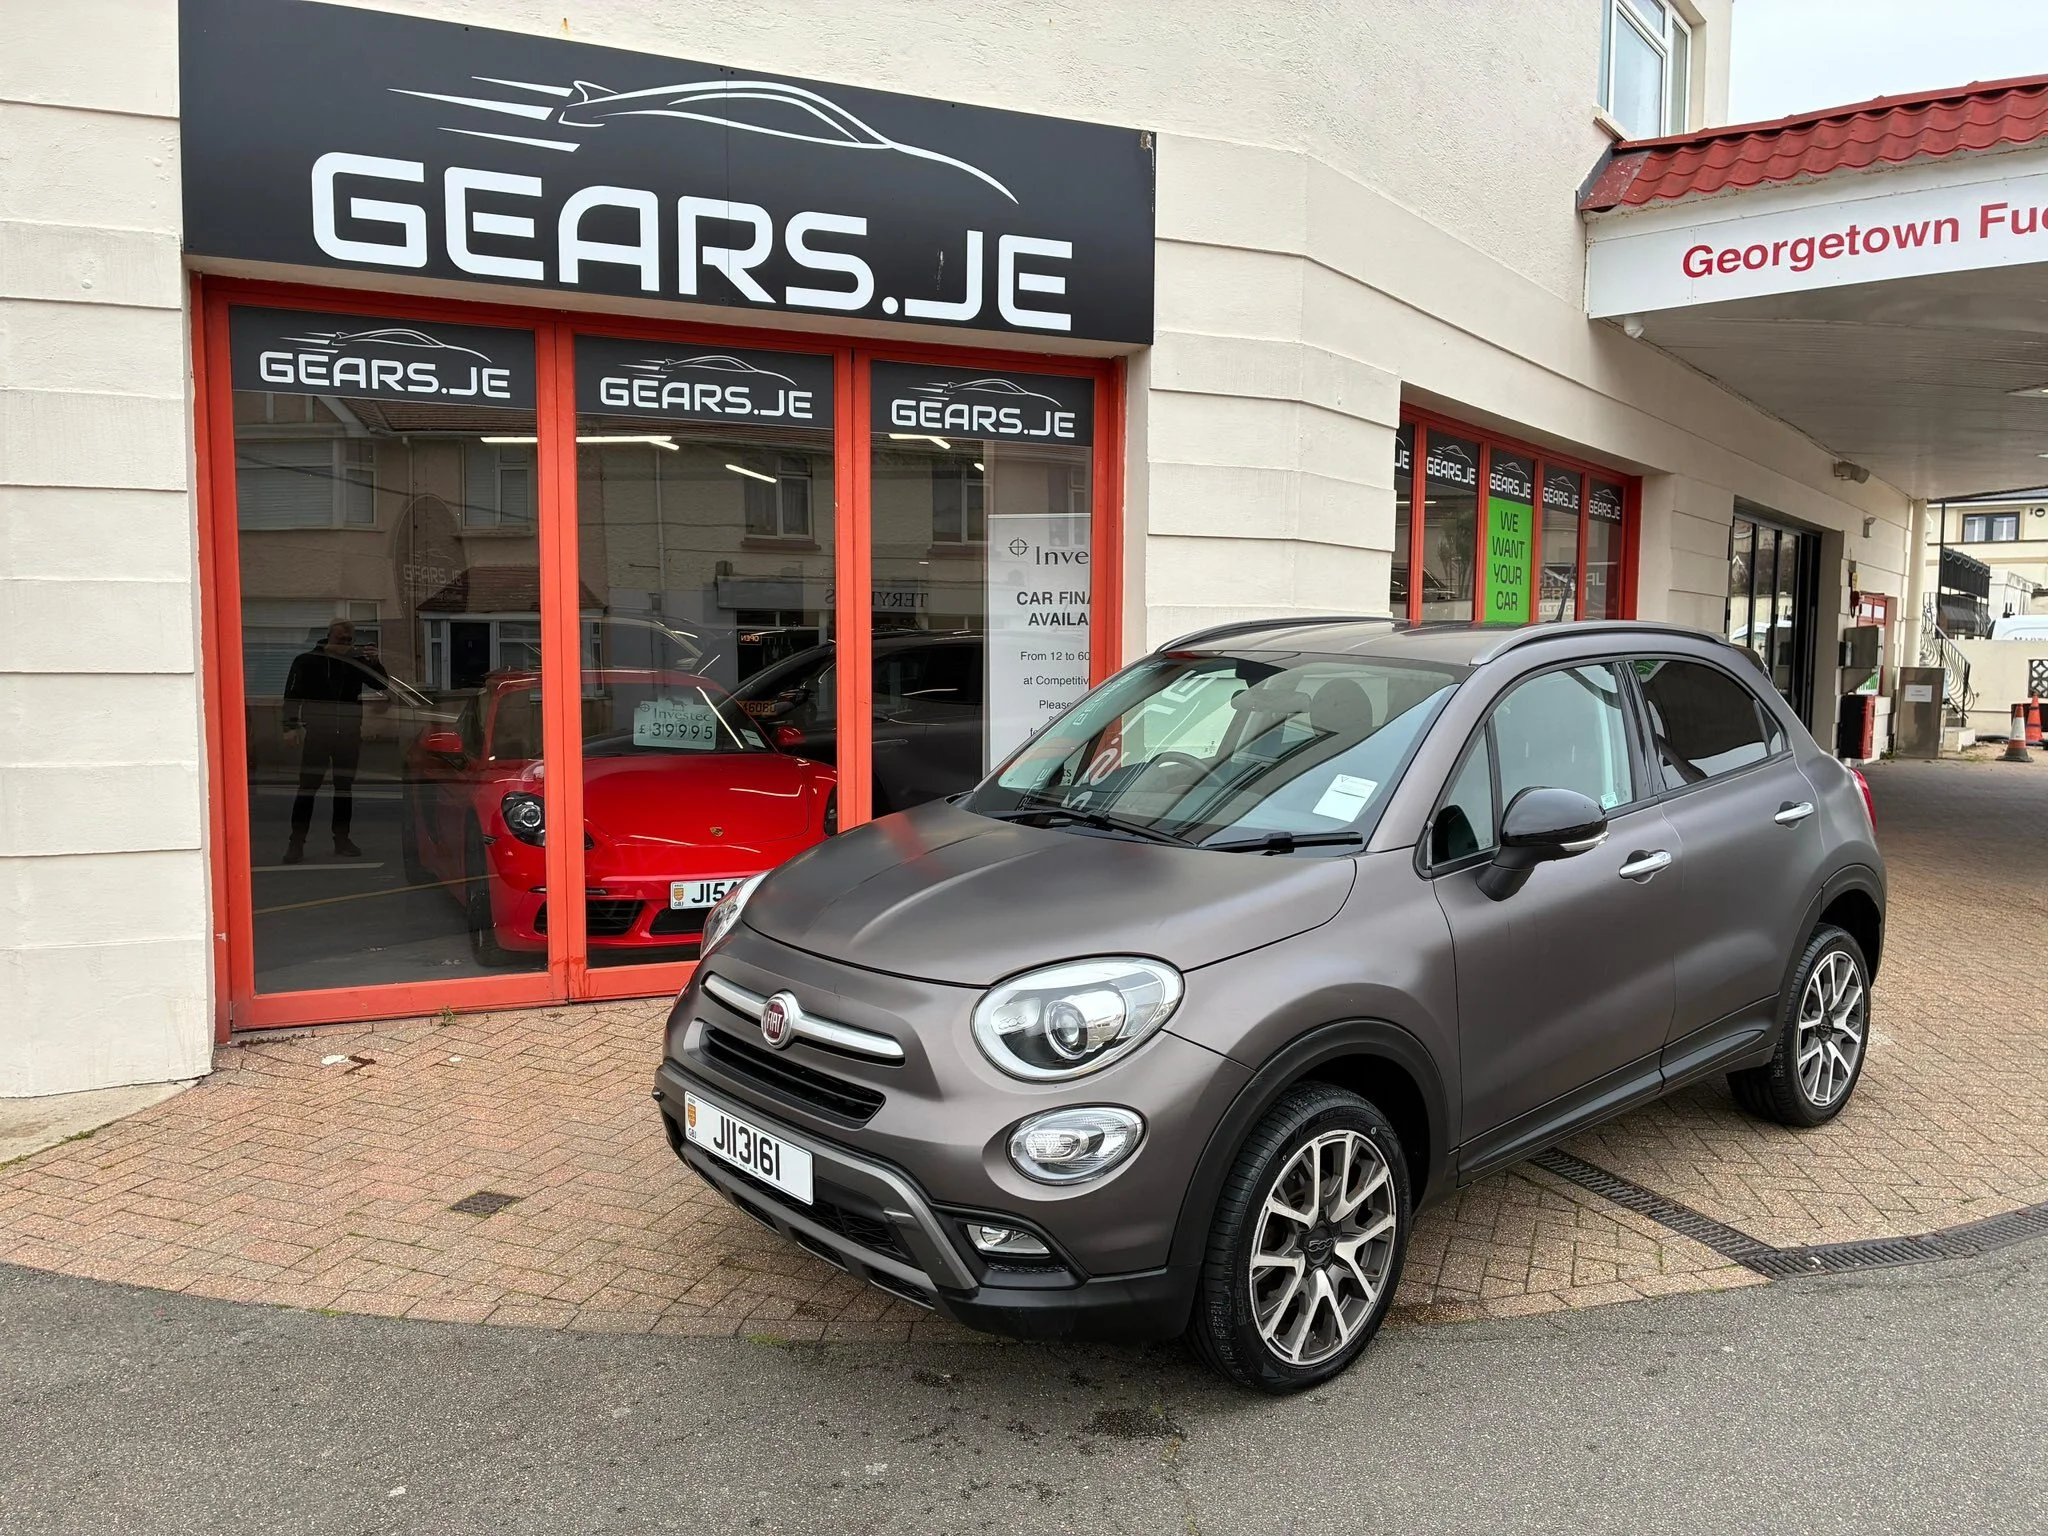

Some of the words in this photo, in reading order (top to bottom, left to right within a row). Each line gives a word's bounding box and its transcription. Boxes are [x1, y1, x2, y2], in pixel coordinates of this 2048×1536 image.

[311, 151, 1074, 332] GEARS.JE
[1682, 216, 1959, 278] Georgetown
[259, 350, 511, 399] GEARS.JE
[600, 376, 813, 419] GEARS.JE
[891, 398, 1076, 439] GEARS.JE
[1500, 510, 1519, 533] WE
[1492, 535, 1526, 559] WANT
[1493, 563, 1522, 586] YOUR
[1016, 591, 1053, 606] CAR
[1496, 590, 1518, 611] CAR
[1020, 651, 1047, 661] From
[1050, 651, 1063, 661] 12
[1065, 652, 1075, 661] to
[1023, 676, 1033, 685] at
[653, 707, 711, 728] Investec
[767, 1010, 783, 1033] FIAT
